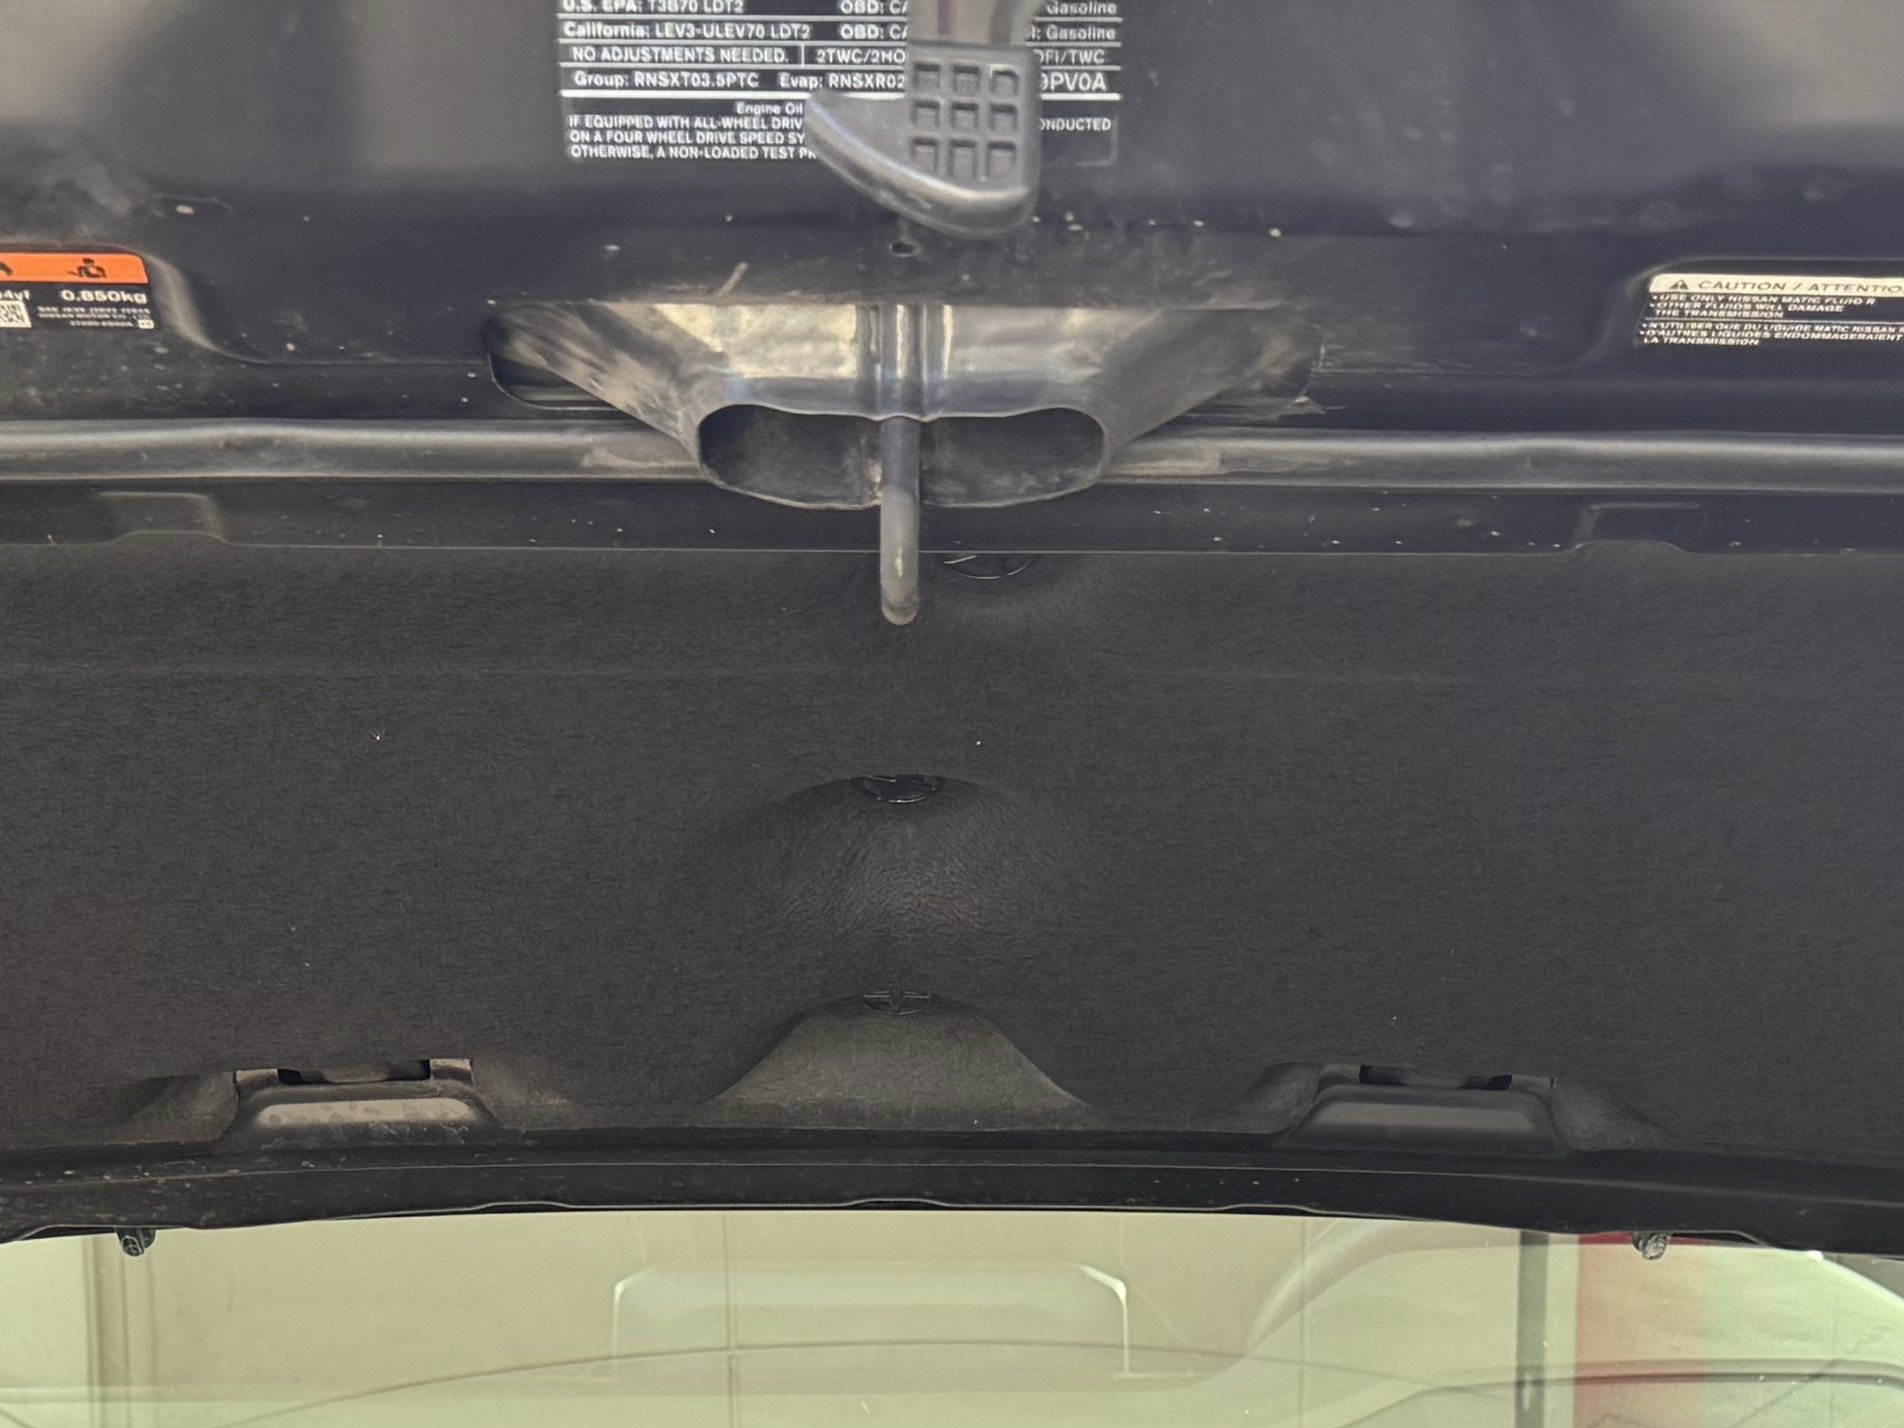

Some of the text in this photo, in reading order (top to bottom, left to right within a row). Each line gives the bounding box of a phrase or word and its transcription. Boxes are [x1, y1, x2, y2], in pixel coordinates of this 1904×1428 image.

[1046, 0, 1117, 15] Gasoline
[563, 21, 812, 39] California: LEV3-ULEV70 LDT2
[840, 24, 885, 39] OBD:
[1046, 24, 1116, 40] Gasoline
[572, 47, 789, 63] NO ADJUSTMENTS NEEDED.
[817, 49, 906, 64] 2TWC/2HO
[574, 71, 629, 88] Group:
[779, 73, 906, 89] Evap: RNSXR02
[735, 103, 803, 115] Engine Oil
[569, 116, 580, 128] IF
[585, 115, 653, 129] EQUIPPED
[656, 116, 691, 129] WITH
[695, 116, 768, 129] ALL-WHEEL
[772, 117, 804, 130] DRIV
[570, 131, 590, 144] ON
[594, 131, 603, 144] A
[606, 131, 643, 144] FOUR
[646, 131, 693, 144] WHEEL
[696, 132, 737, 145] DRIVE
[739, 132, 785, 145] SPEED
[571, 146, 654, 160] OTHERWISE,
[657, 146, 665, 159] A
[669, 147, 759, 160] NON-LOADED
[763, 148, 795, 160] TEST
[1698, 280, 1787, 291] CAUTION
[1787, 304, 1844, 312] DAMAGE
